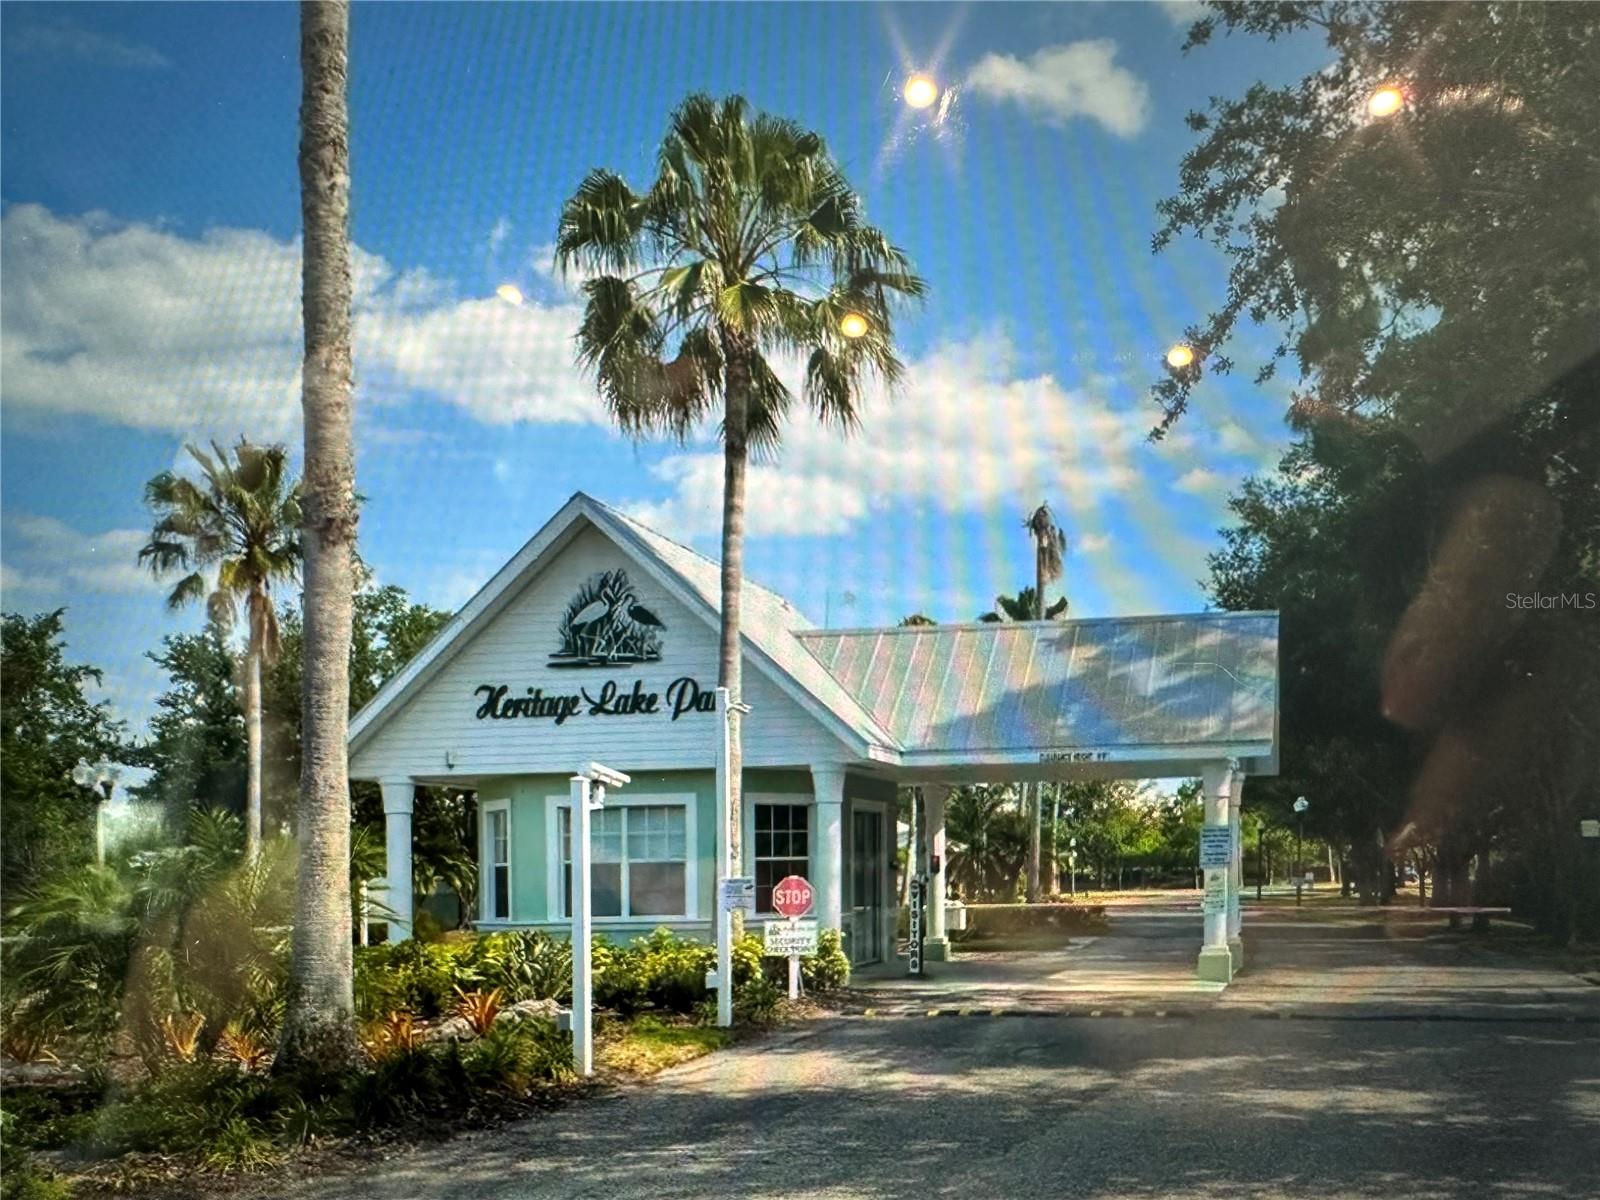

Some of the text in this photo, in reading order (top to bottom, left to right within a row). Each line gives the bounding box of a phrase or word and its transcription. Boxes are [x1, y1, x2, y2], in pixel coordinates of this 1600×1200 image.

[475, 677, 717, 725] Heritage Lake Pa
[775, 889, 811, 905] STOP
